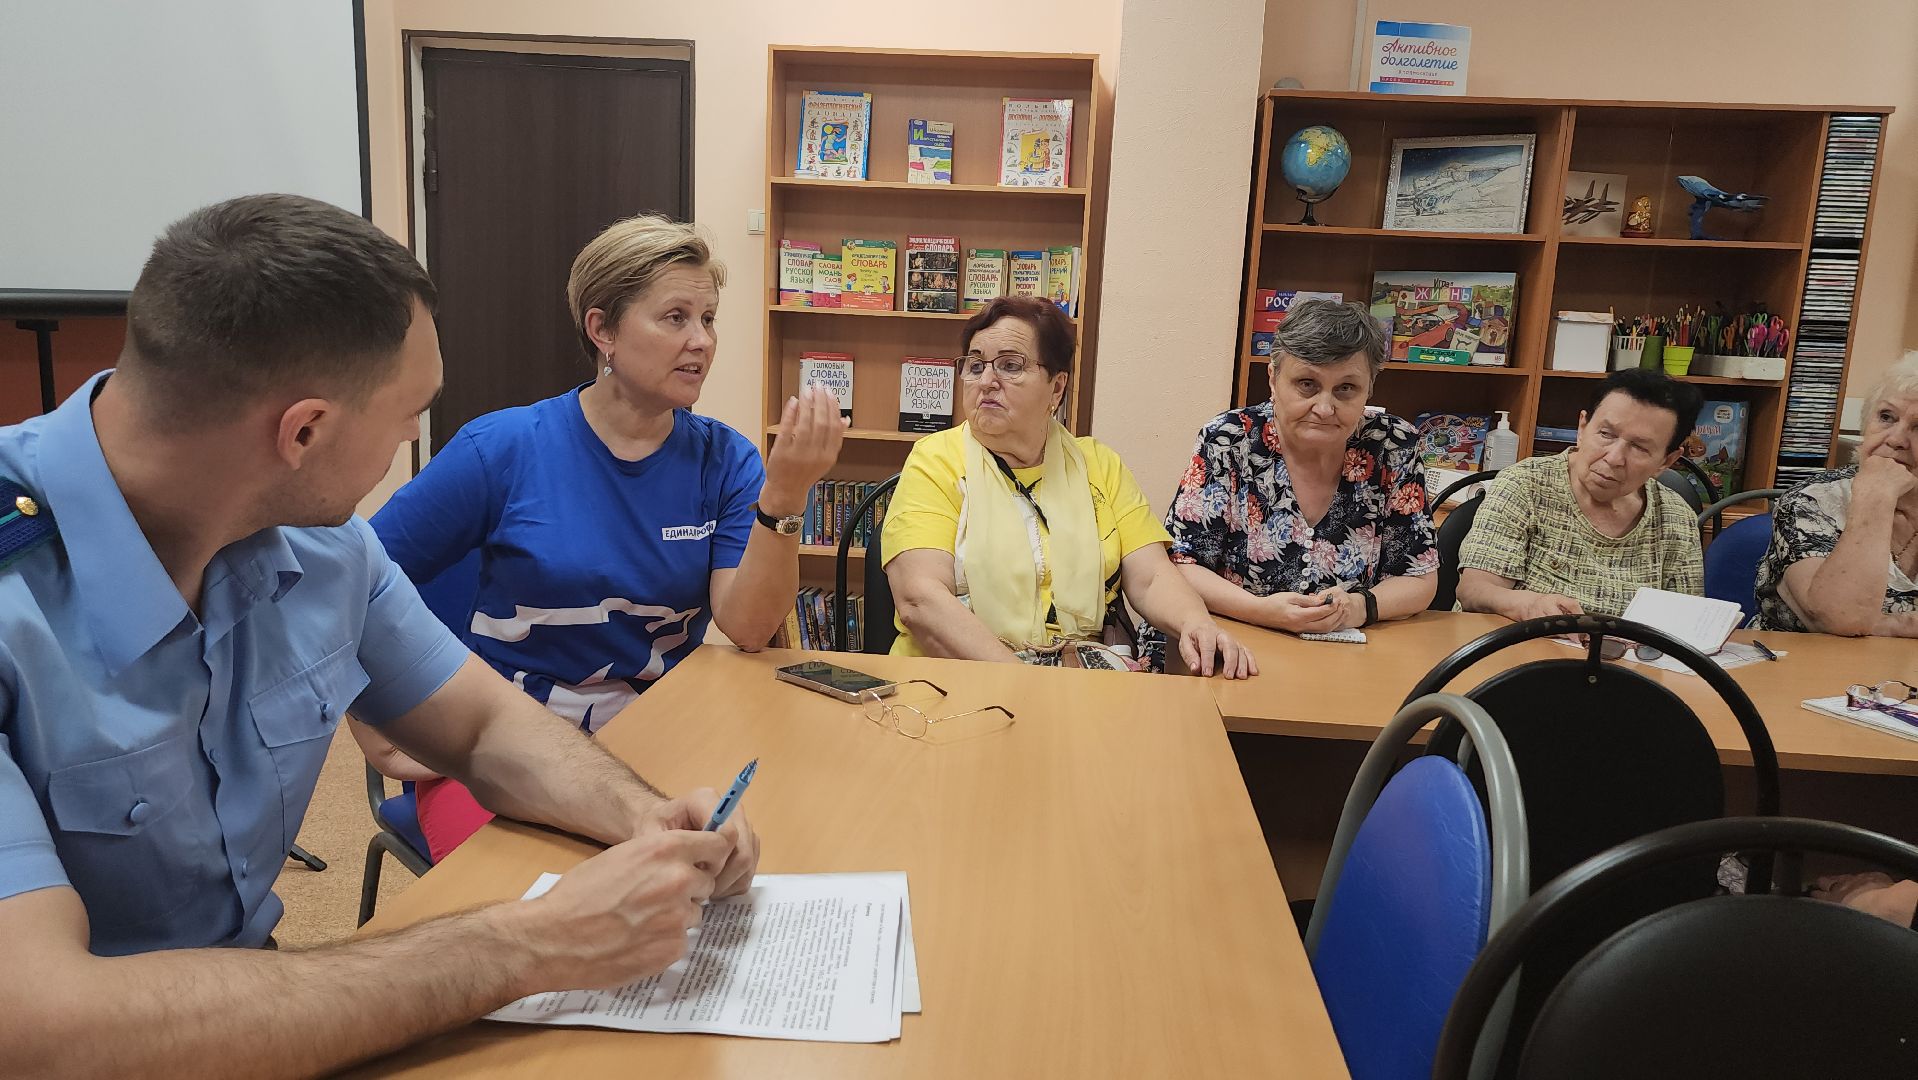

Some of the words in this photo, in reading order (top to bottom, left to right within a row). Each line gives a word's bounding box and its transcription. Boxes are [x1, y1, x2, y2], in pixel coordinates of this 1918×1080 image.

[1382, 38, 1457, 56] Активное
[1381, 53, 1459, 70] долголетие
[925, 244, 955, 252] СЛОВАРЬ
[788, 259, 813, 268] СЛОВАР
[851, 259, 888, 269] СЛОВАРЬ
[968, 273, 999, 282] СЛОВАРЬ
[810, 369, 848, 379] СЛОВАРЬ
[908, 366, 949, 378] СЛОВАРЬ
[905, 377, 951, 390] УДАРЕНИЙ
[905, 388, 950, 400] РУССКОГО
[912, 399, 943, 410] ЯЗЫКА
